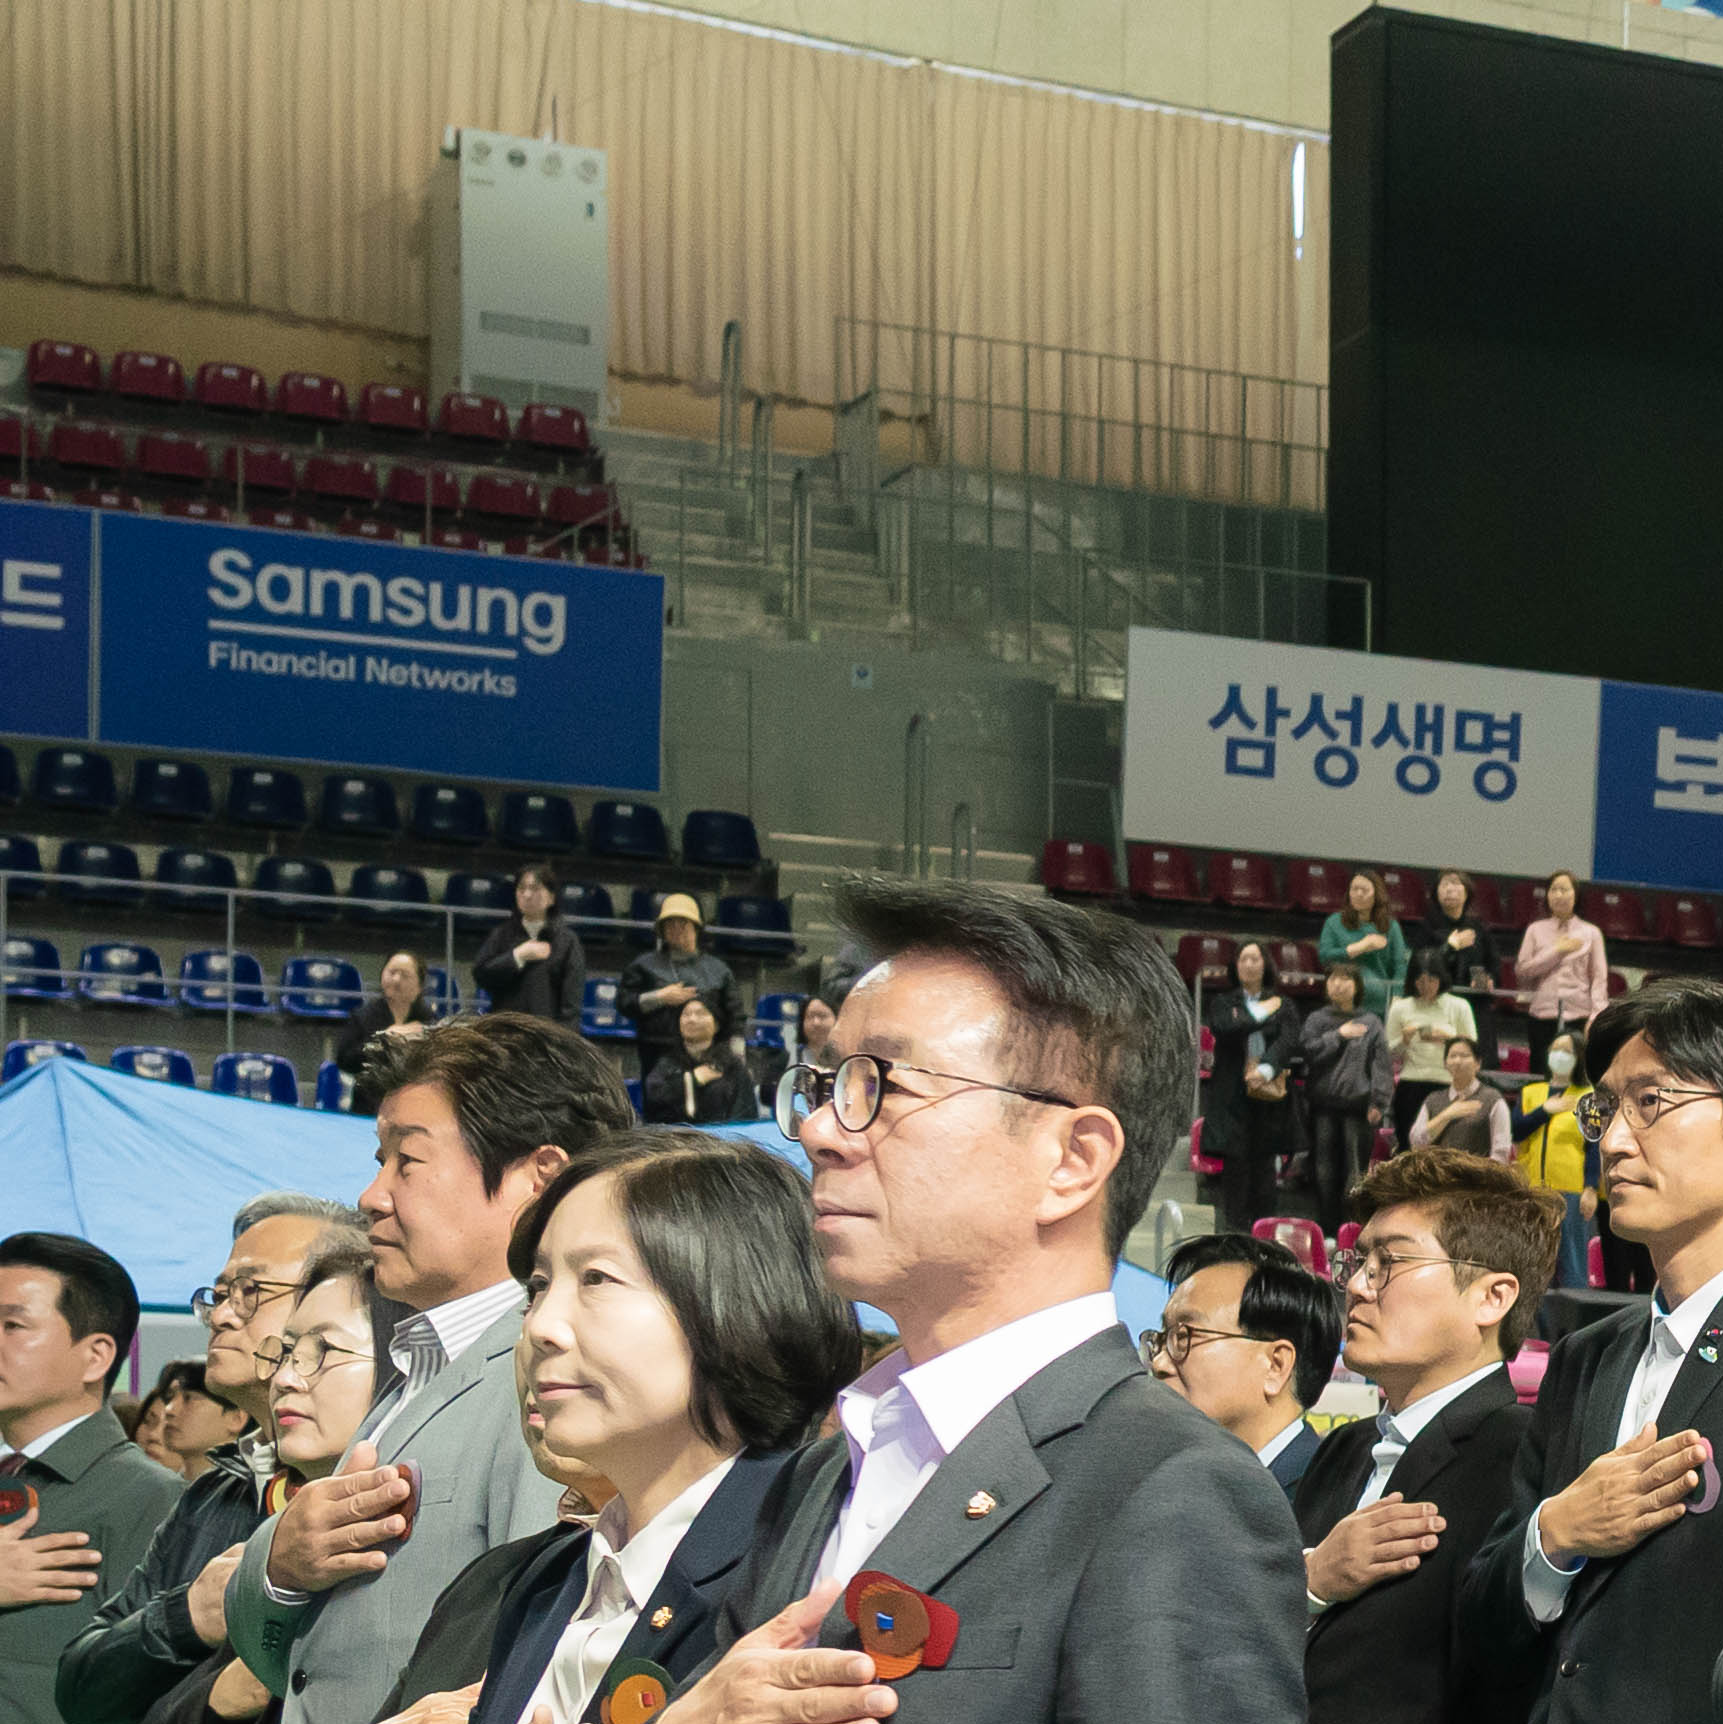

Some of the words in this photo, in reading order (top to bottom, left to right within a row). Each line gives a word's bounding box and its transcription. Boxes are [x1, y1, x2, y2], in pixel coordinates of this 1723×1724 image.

[207, 547, 567, 656] Samsung
[208, 641, 356, 682] Financial
[365, 650, 518, 698] Networks
[1208, 683, 1523, 802] 삼성생명
